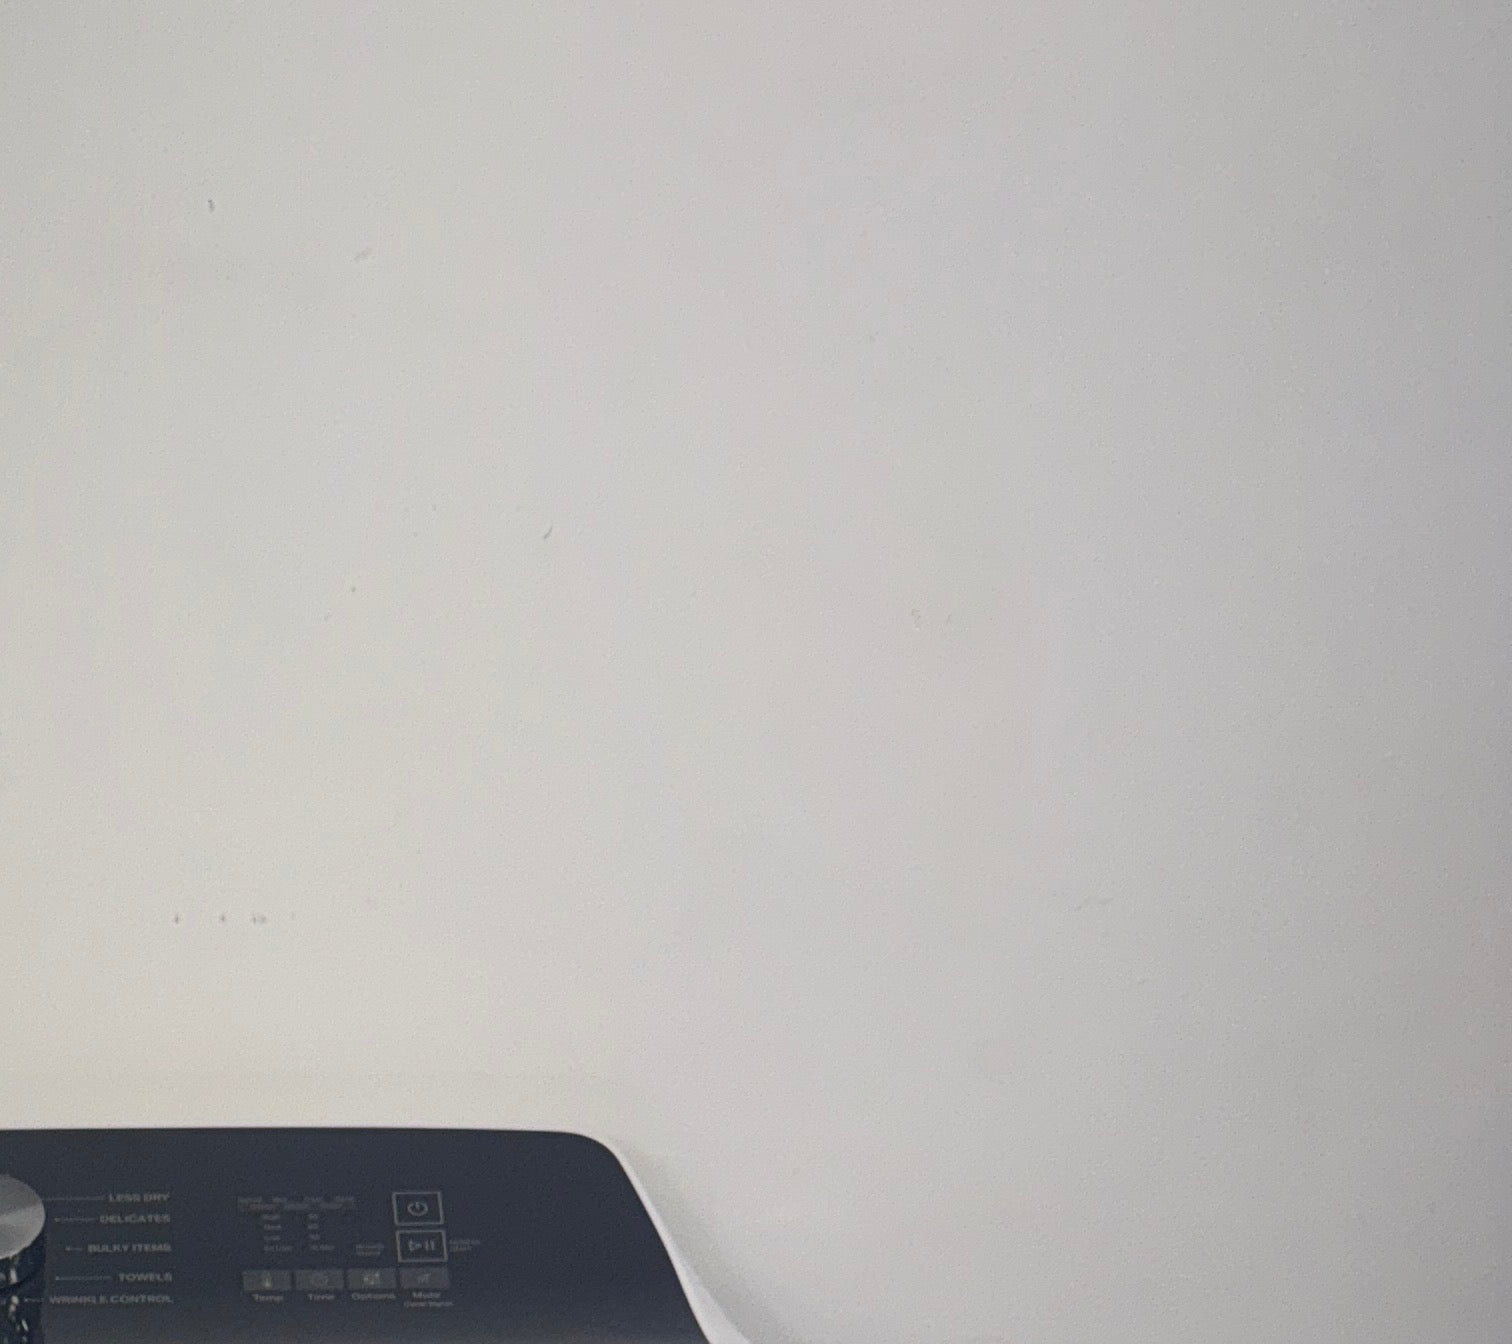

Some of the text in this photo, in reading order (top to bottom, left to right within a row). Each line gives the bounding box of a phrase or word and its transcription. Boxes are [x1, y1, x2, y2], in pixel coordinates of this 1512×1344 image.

[143, 1193, 170, 1202] DRY
[99, 1214, 171, 1224] DELICATES
[87, 1243, 172, 1253] BULKY ITEMS
[118, 1273, 172, 1282] TOWELS
[49, 1294, 173, 1305] WRINKLE CONTROL
